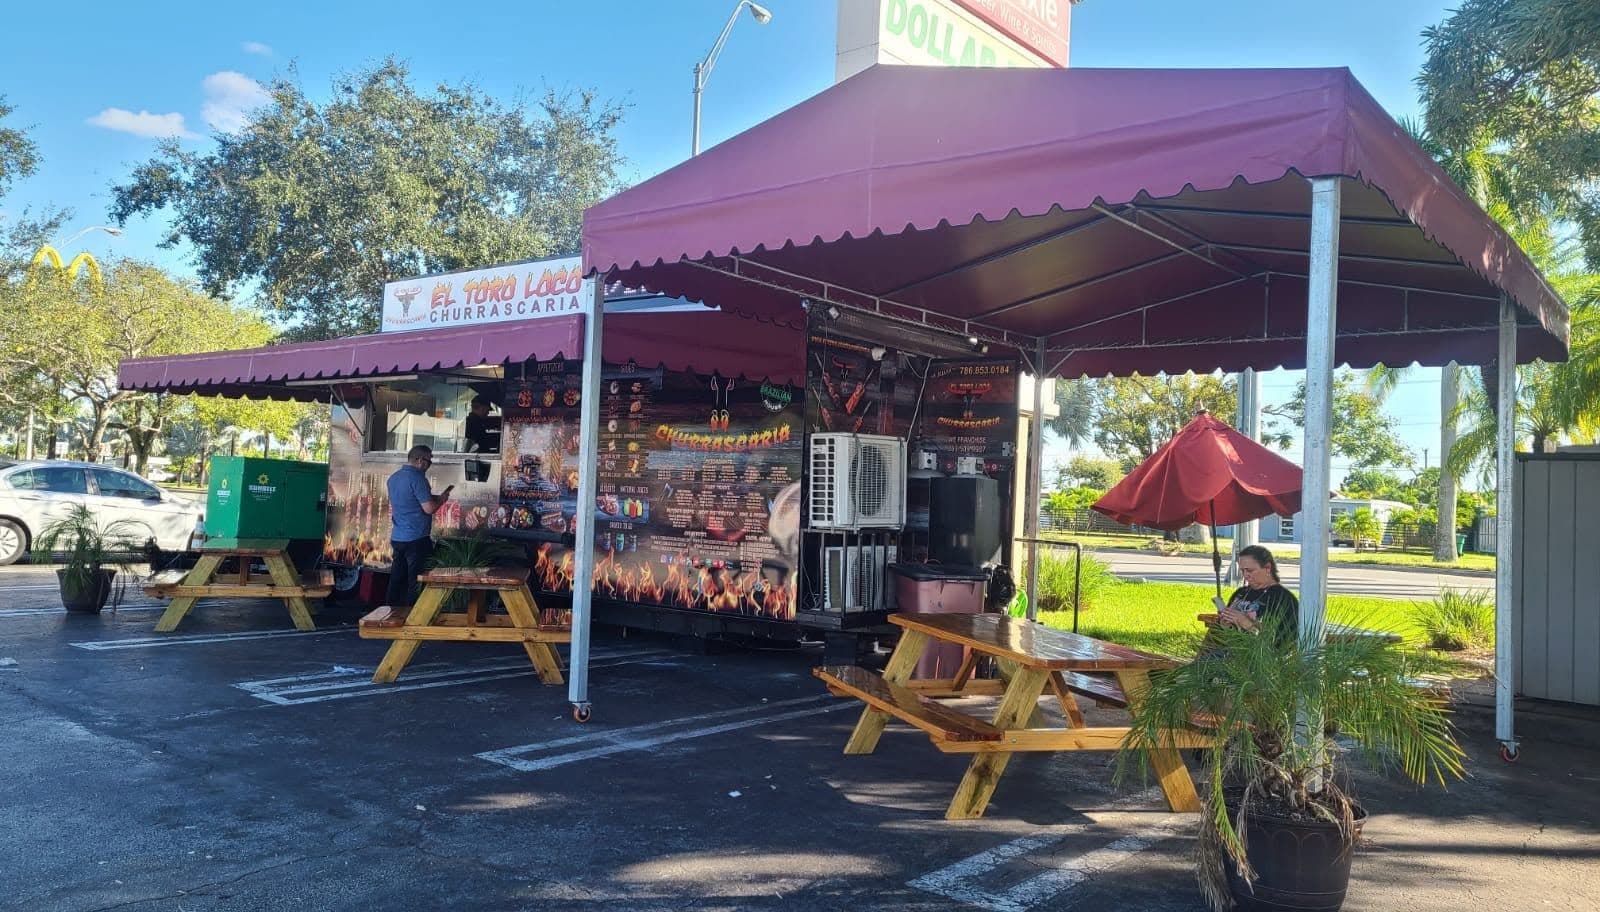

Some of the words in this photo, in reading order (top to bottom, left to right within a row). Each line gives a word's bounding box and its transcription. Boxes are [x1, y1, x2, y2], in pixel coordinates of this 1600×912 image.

[1001, 2, 1022, 30] Wine
[431, 282, 456, 310] EL
[462, 273, 517, 305] TORO
[525, 265, 582, 299] LOCO
[430, 295, 580, 323] CHURRASCARIA
[656, 424, 791, 452] CHURRASCARIA
